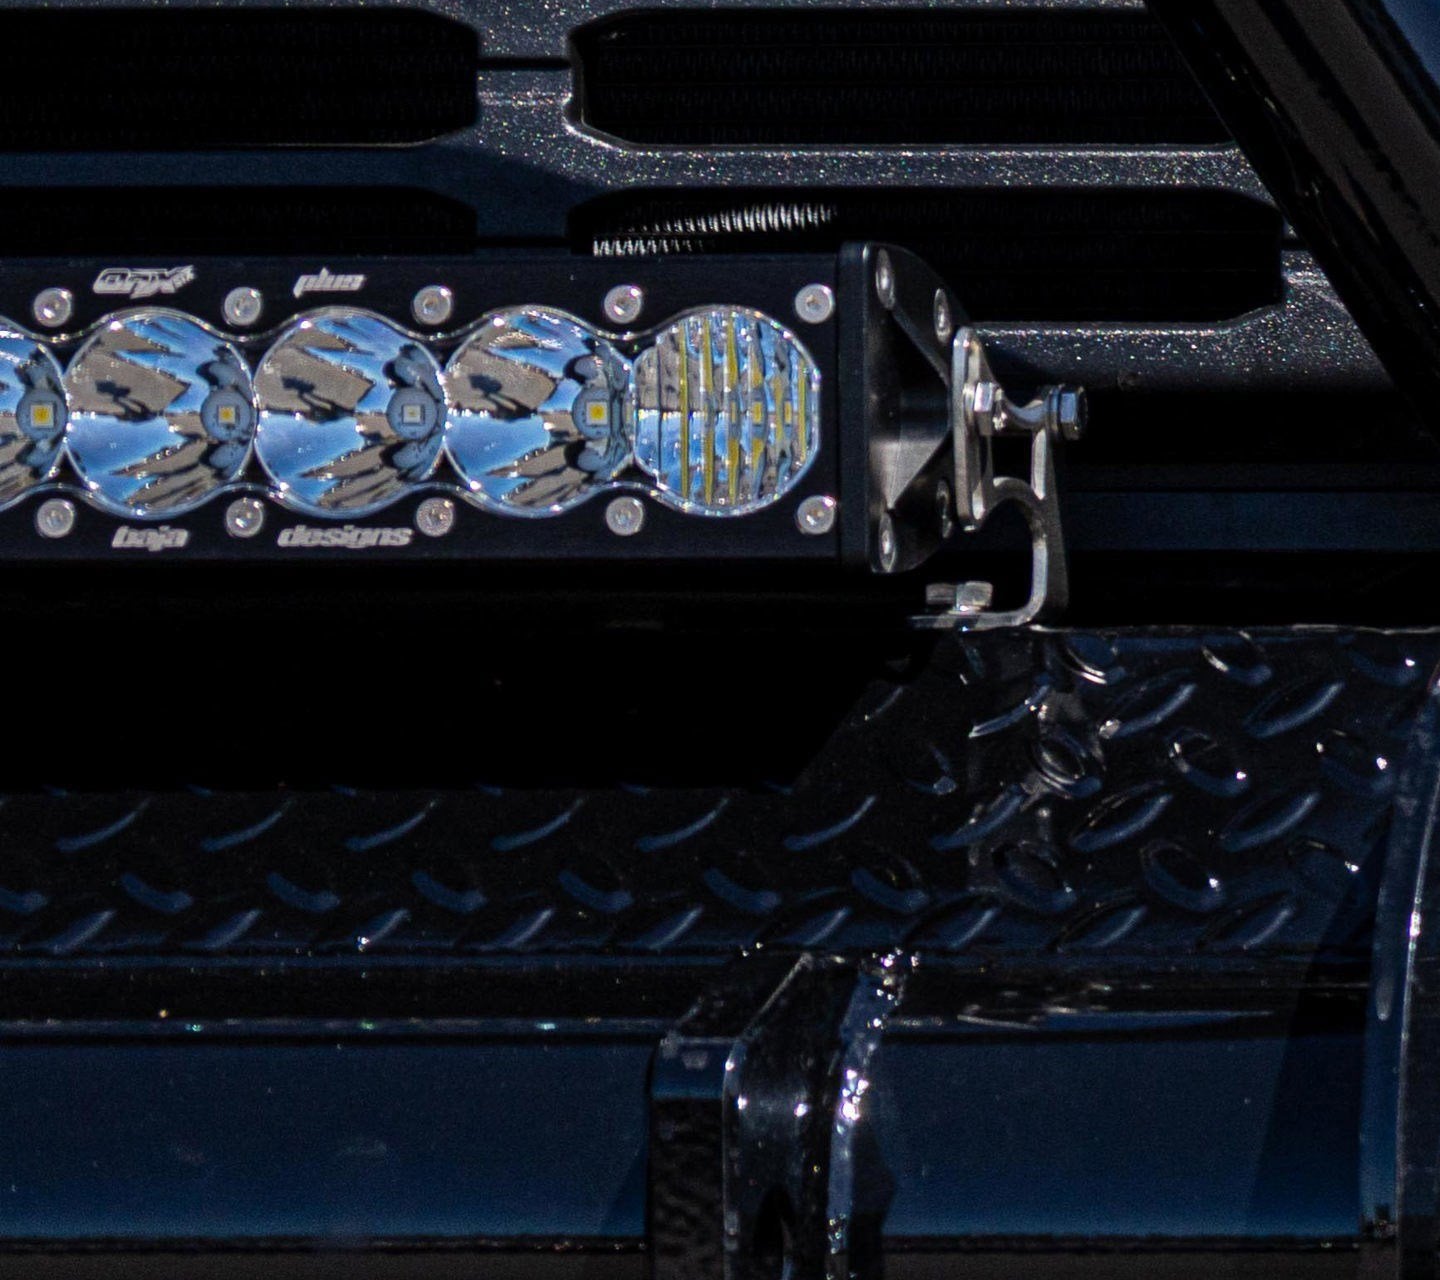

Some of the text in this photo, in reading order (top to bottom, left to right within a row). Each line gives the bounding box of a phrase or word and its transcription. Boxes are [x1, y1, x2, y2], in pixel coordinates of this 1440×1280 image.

[293, 267, 365, 298] plus
[112, 525, 413, 551] baja designs
